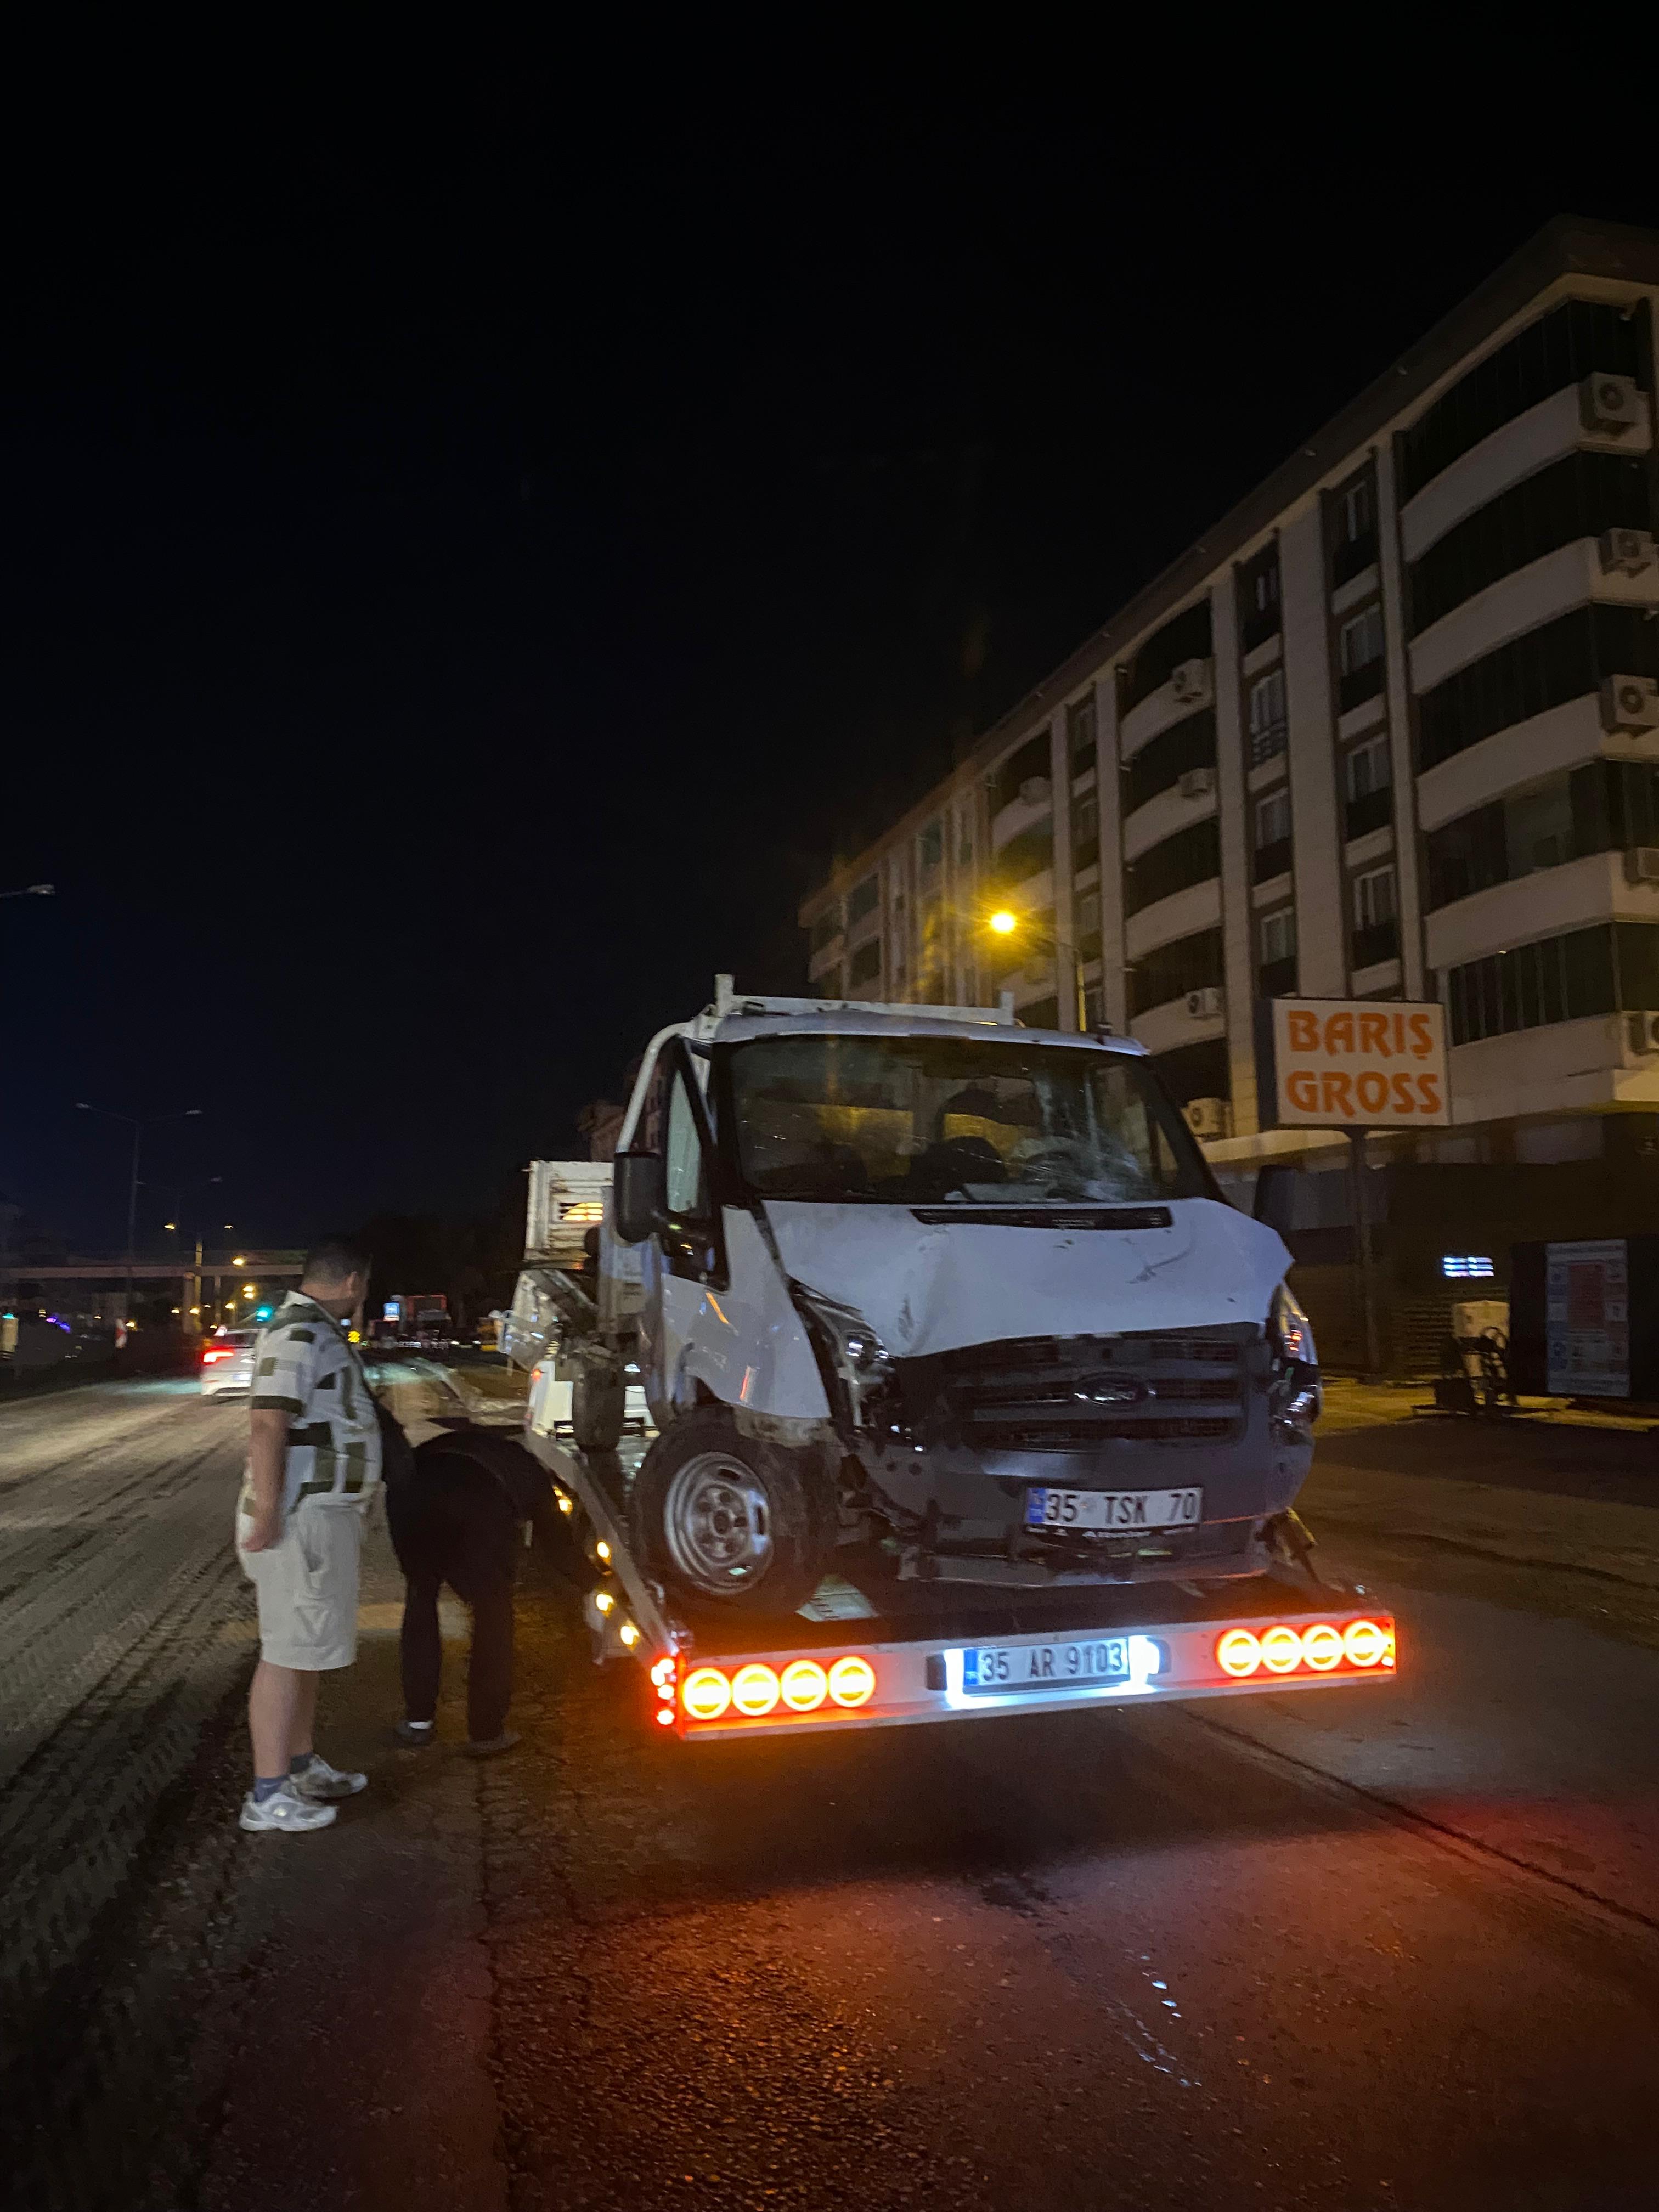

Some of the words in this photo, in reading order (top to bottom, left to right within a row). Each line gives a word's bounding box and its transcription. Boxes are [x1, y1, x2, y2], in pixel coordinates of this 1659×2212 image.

[1287, 1010, 1434, 1060] BARIŞ
[1285, 1070, 1441, 1117] GROSS
[1045, 1494, 1080, 1522] 35
[1168, 1492, 1196, 1522] 70
[981, 1651, 1010, 1681] 35
[1029, 1648, 1056, 1677] AR
[1067, 1643, 1122, 1674] 9103
